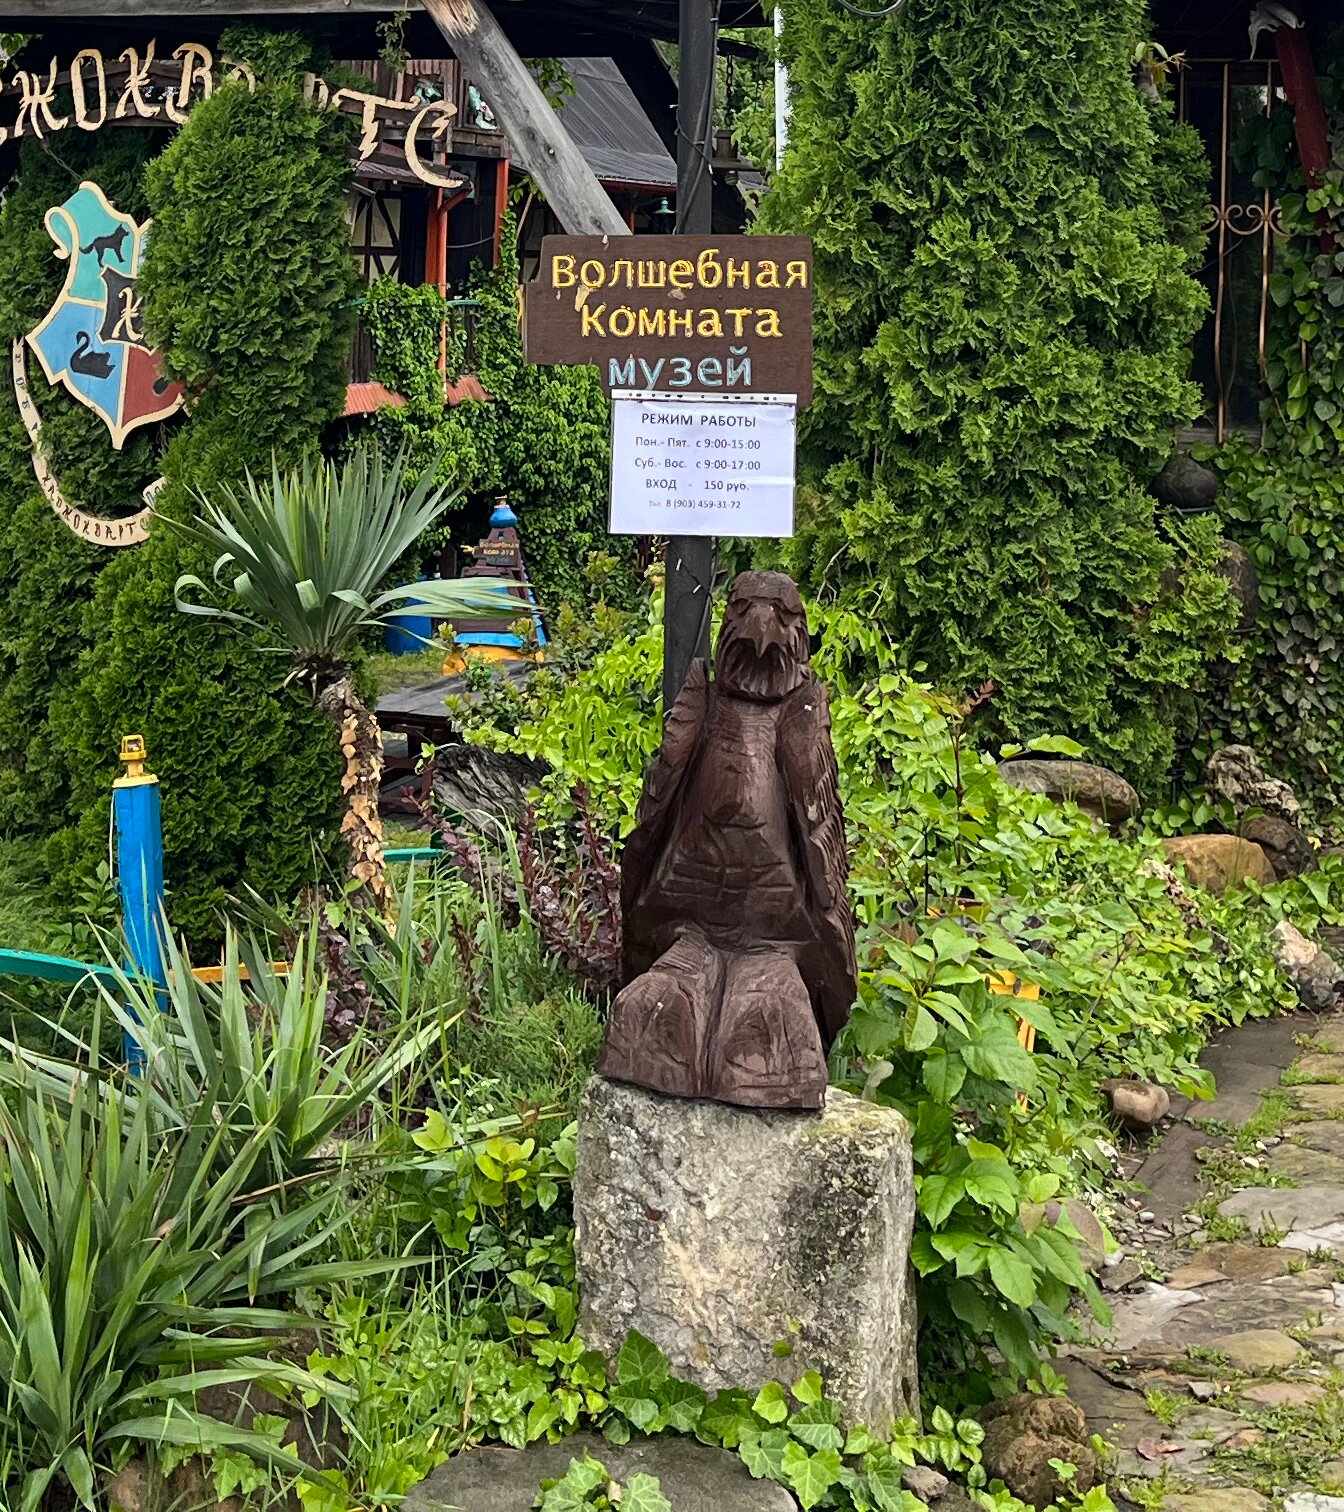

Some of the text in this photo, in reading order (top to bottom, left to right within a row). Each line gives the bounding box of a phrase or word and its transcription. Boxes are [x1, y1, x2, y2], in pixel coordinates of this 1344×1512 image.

[552, 248, 807, 289] Волшебная
[609, 346, 752, 390] музей
[641, 413, 756, 428] РЕЖИМ РАБОТЫ
[704, 439, 761, 449] 9:00-15:00
[704, 460, 761, 470] 9:00-17:00
[646, 479, 677, 489] ВХОД
[704, 480, 723, 490] 150
[727, 481, 749, 492] руб.
[666, 499, 671, 508] 8
[673, 499, 695, 509] (903)
[697, 500, 741, 509] 459-31-72
